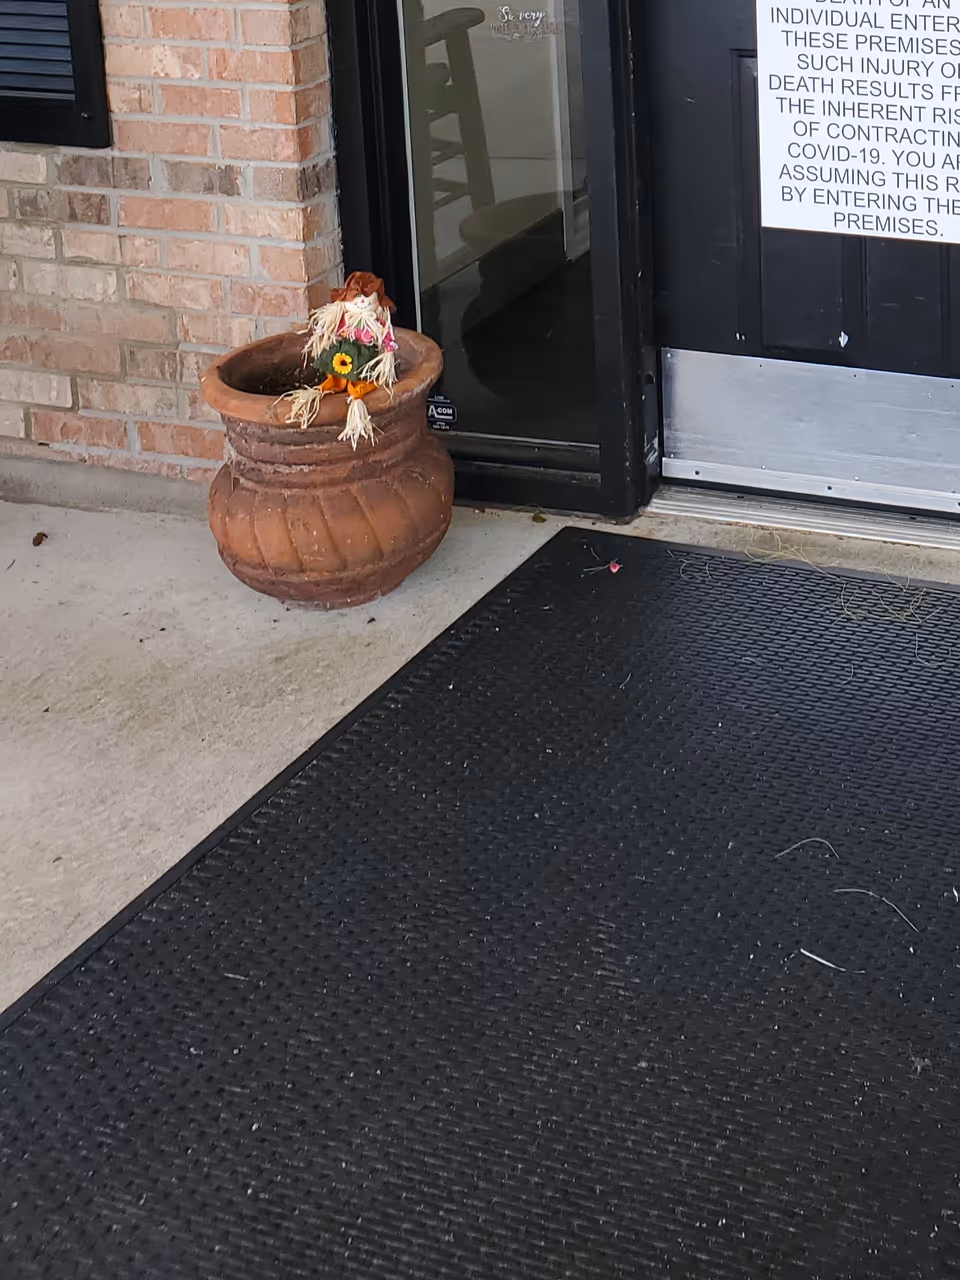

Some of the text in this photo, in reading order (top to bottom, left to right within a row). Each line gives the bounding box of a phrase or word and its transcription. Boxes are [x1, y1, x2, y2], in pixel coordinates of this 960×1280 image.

[519, 12, 545, 27] very
[771, 6, 884, 29] INDIVIDUAL
[781, 29, 848, 49] THESE
[855, 33, 960, 56] PREMISES
[797, 53, 853, 72] SUCH
[861, 56, 934, 77] INJURY
[769, 74, 833, 94] DEATH
[841, 78, 933, 100] RESULTS
[775, 96, 815, 115] THE
[822, 99, 926, 122] INHERENT
[793, 120, 820, 137] OF
[787, 142, 885, 164] COVID-19.
[891, 149, 935, 168] YOU
[778, 163, 885, 187] ASSUMING
[891, 171, 938, 191] THIS
[781, 185, 806, 202] BY
[813, 187, 916, 211] ENTERING
[833, 211, 943, 236] PREMISES.
